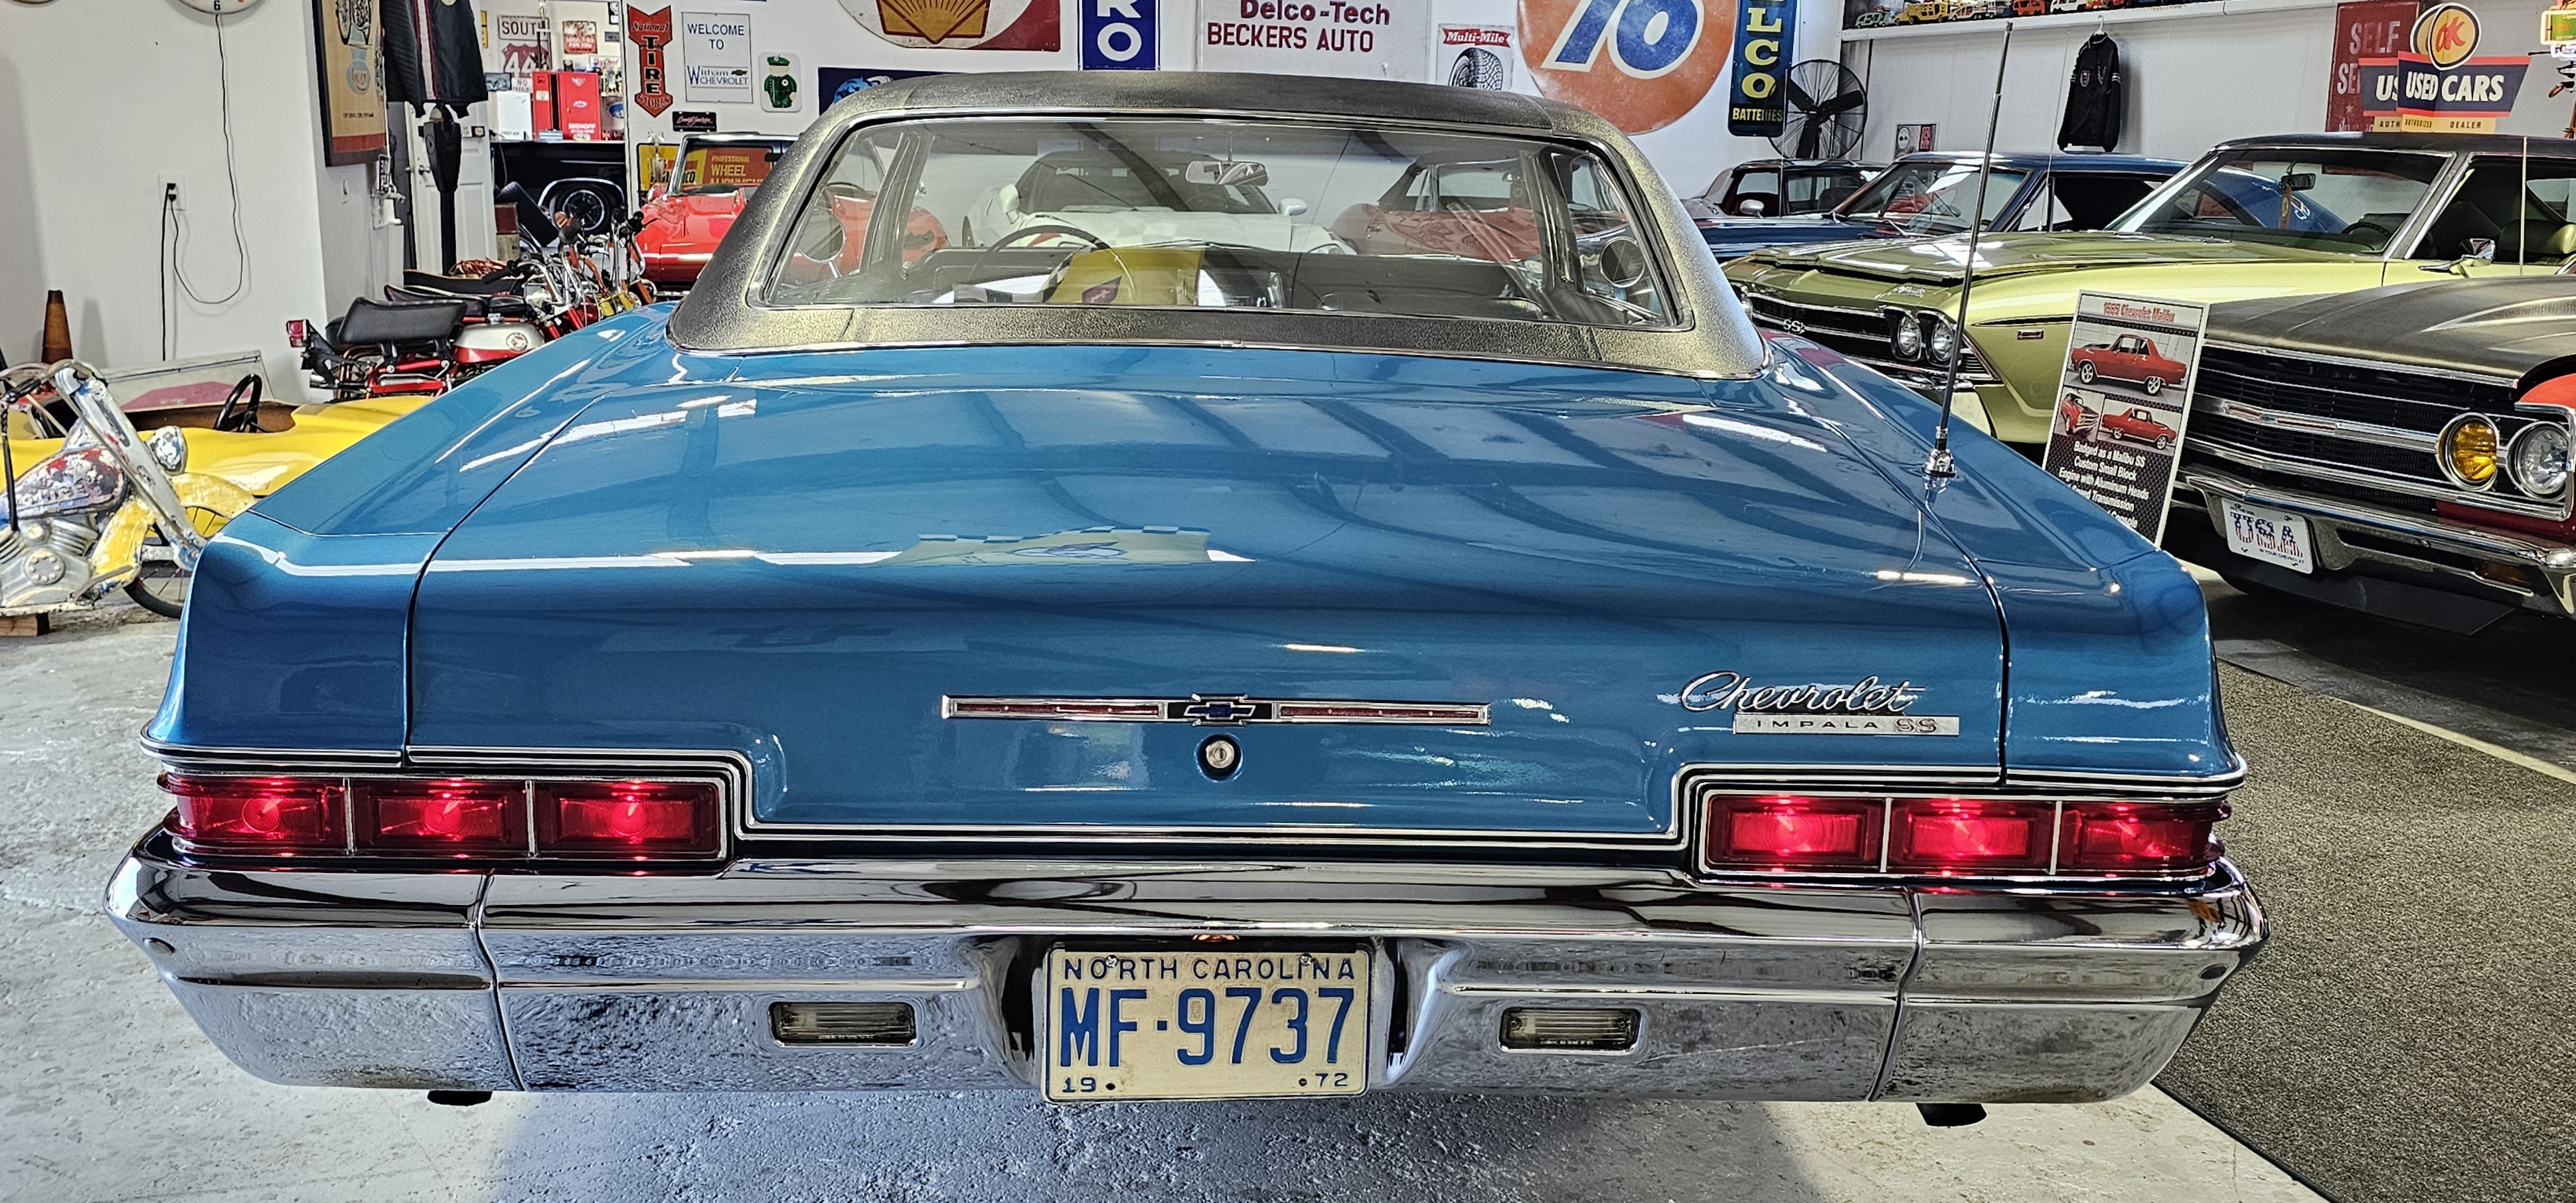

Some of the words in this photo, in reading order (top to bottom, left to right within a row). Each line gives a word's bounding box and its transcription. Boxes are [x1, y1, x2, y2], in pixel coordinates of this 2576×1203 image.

[214, 0, 220, 11] 6
[1240, 0, 1390, 25] Delco-Tech
[502, 21, 546, 36] SOUTH
[631, 21, 669, 33] National
[687, 23, 744, 35] WELCOME
[1208, 23, 1307, 49] BECKERS
[1317, 29, 1374, 52] AUTO
[1446, 31, 1506, 44] Multi-Mile
[2435, 17, 2466, 52] OK
[709, 39, 724, 50] TO
[2350, 21, 2401, 55] SELF
[1741, 0, 1784, 99] LCO
[641, 35, 662, 94] TIRE
[700, 76, 749, 85] CHEVROLET
[2405, 71, 2439, 101] USED
[2441, 75, 2504, 102] CARS
[2405, 119, 2433, 128] AUTHORIZED
[711, 164, 746, 176] WHEEL
[2121, 304, 2152, 320] Chevrolet
[2152, 307, 2175, 323] Malibu
[2073, 441, 2098, 457] Badged
[2098, 449, 2107, 458] as
[2107, 451, 2112, 460] a
[2112, 450, 2135, 465] Malibu
[2134, 455, 2146, 468] SS
[2074, 455, 2098, 471] Custom
[2099, 461, 2118, 477] Small
[2117, 466, 2137, 481] Block
[2059, 467, 2081, 482] Engine
[2081, 473, 2095, 485] with
[2093, 476, 2127, 494] Aluminum
[2127, 484, 2149, 500] Heads
[2092, 491, 2134, 512] Transmission
[2230, 511, 2302, 558] USA
[1681, 671, 1921, 712] Chevrolet
[1757, 720, 1879, 730] IMPALA
[1893, 718, 1938, 733] SS
[1064, 958, 1179, 981] NORTH
[1192, 957, 1355, 980] CAROLINA
[1062, 1076, 1097, 1093] 19
[1315, 1073, 1349, 1087] 72
